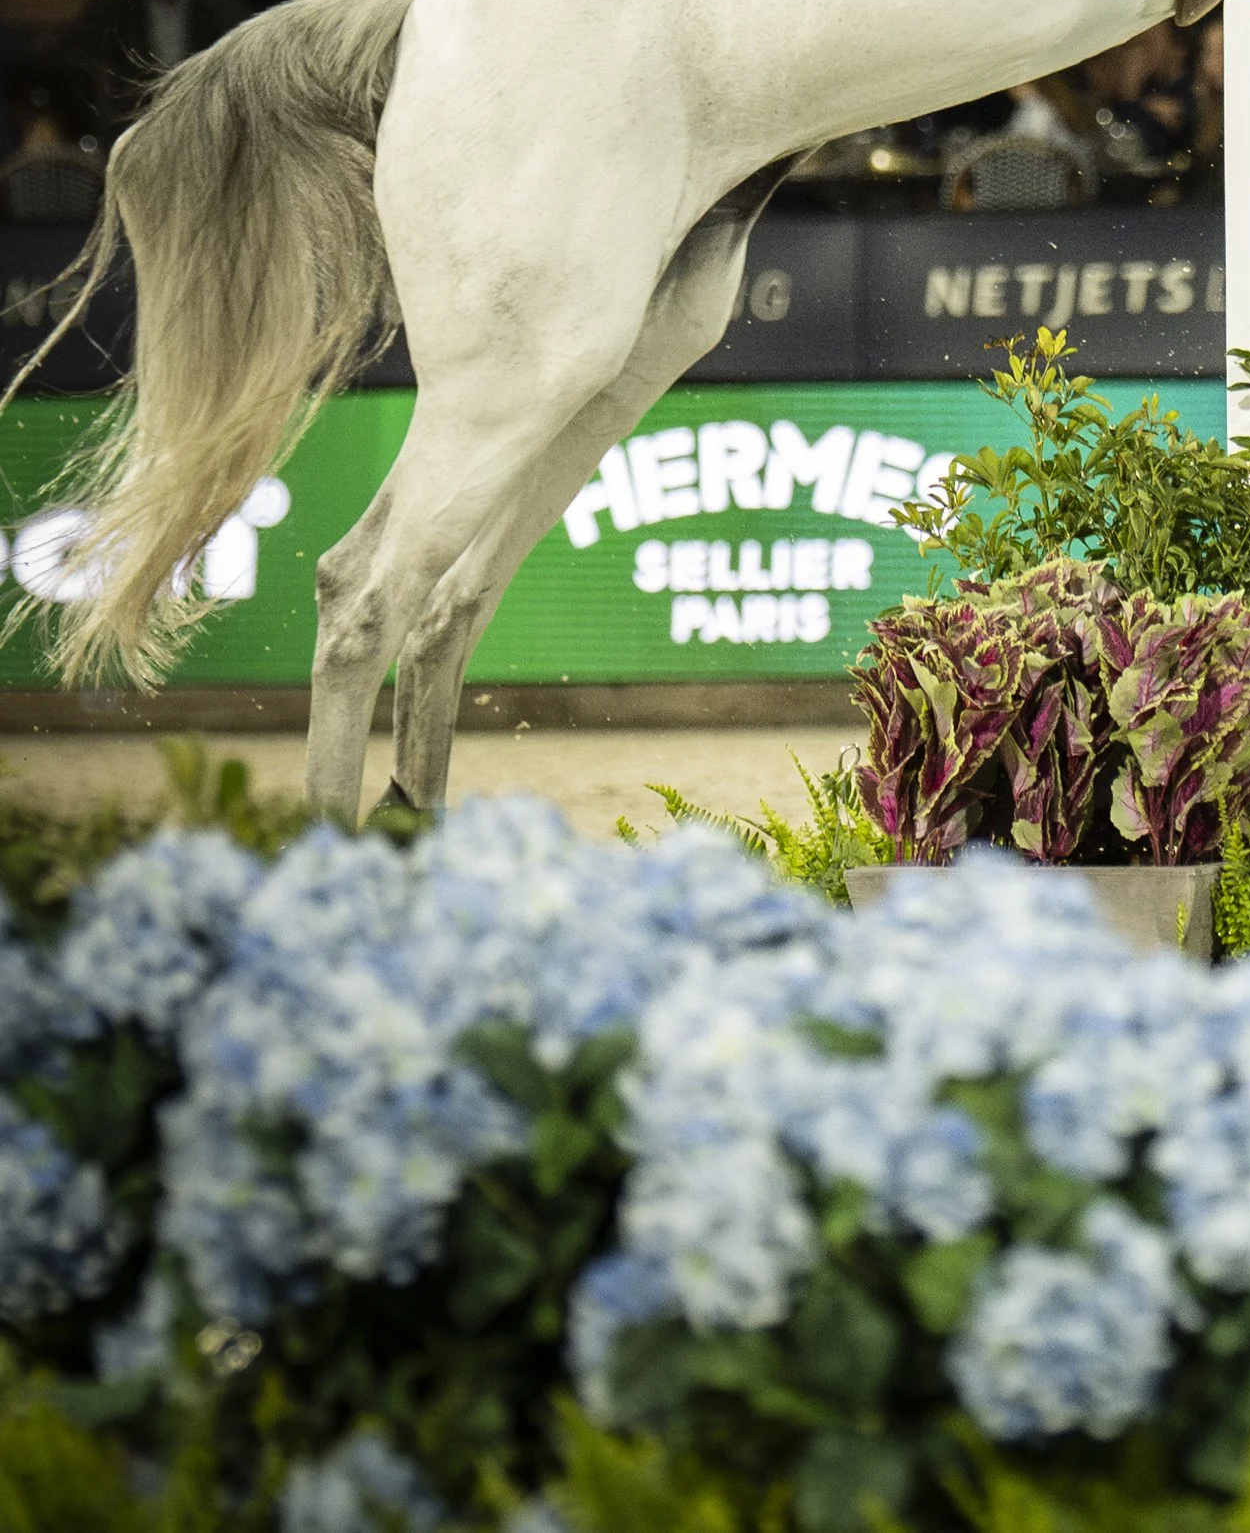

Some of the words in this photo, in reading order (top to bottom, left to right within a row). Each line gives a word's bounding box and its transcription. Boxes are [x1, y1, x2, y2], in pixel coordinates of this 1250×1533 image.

[925, 262, 1195, 330] NETJETS
[633, 538, 874, 592] SELLIER
[670, 592, 831, 644] PARIS
